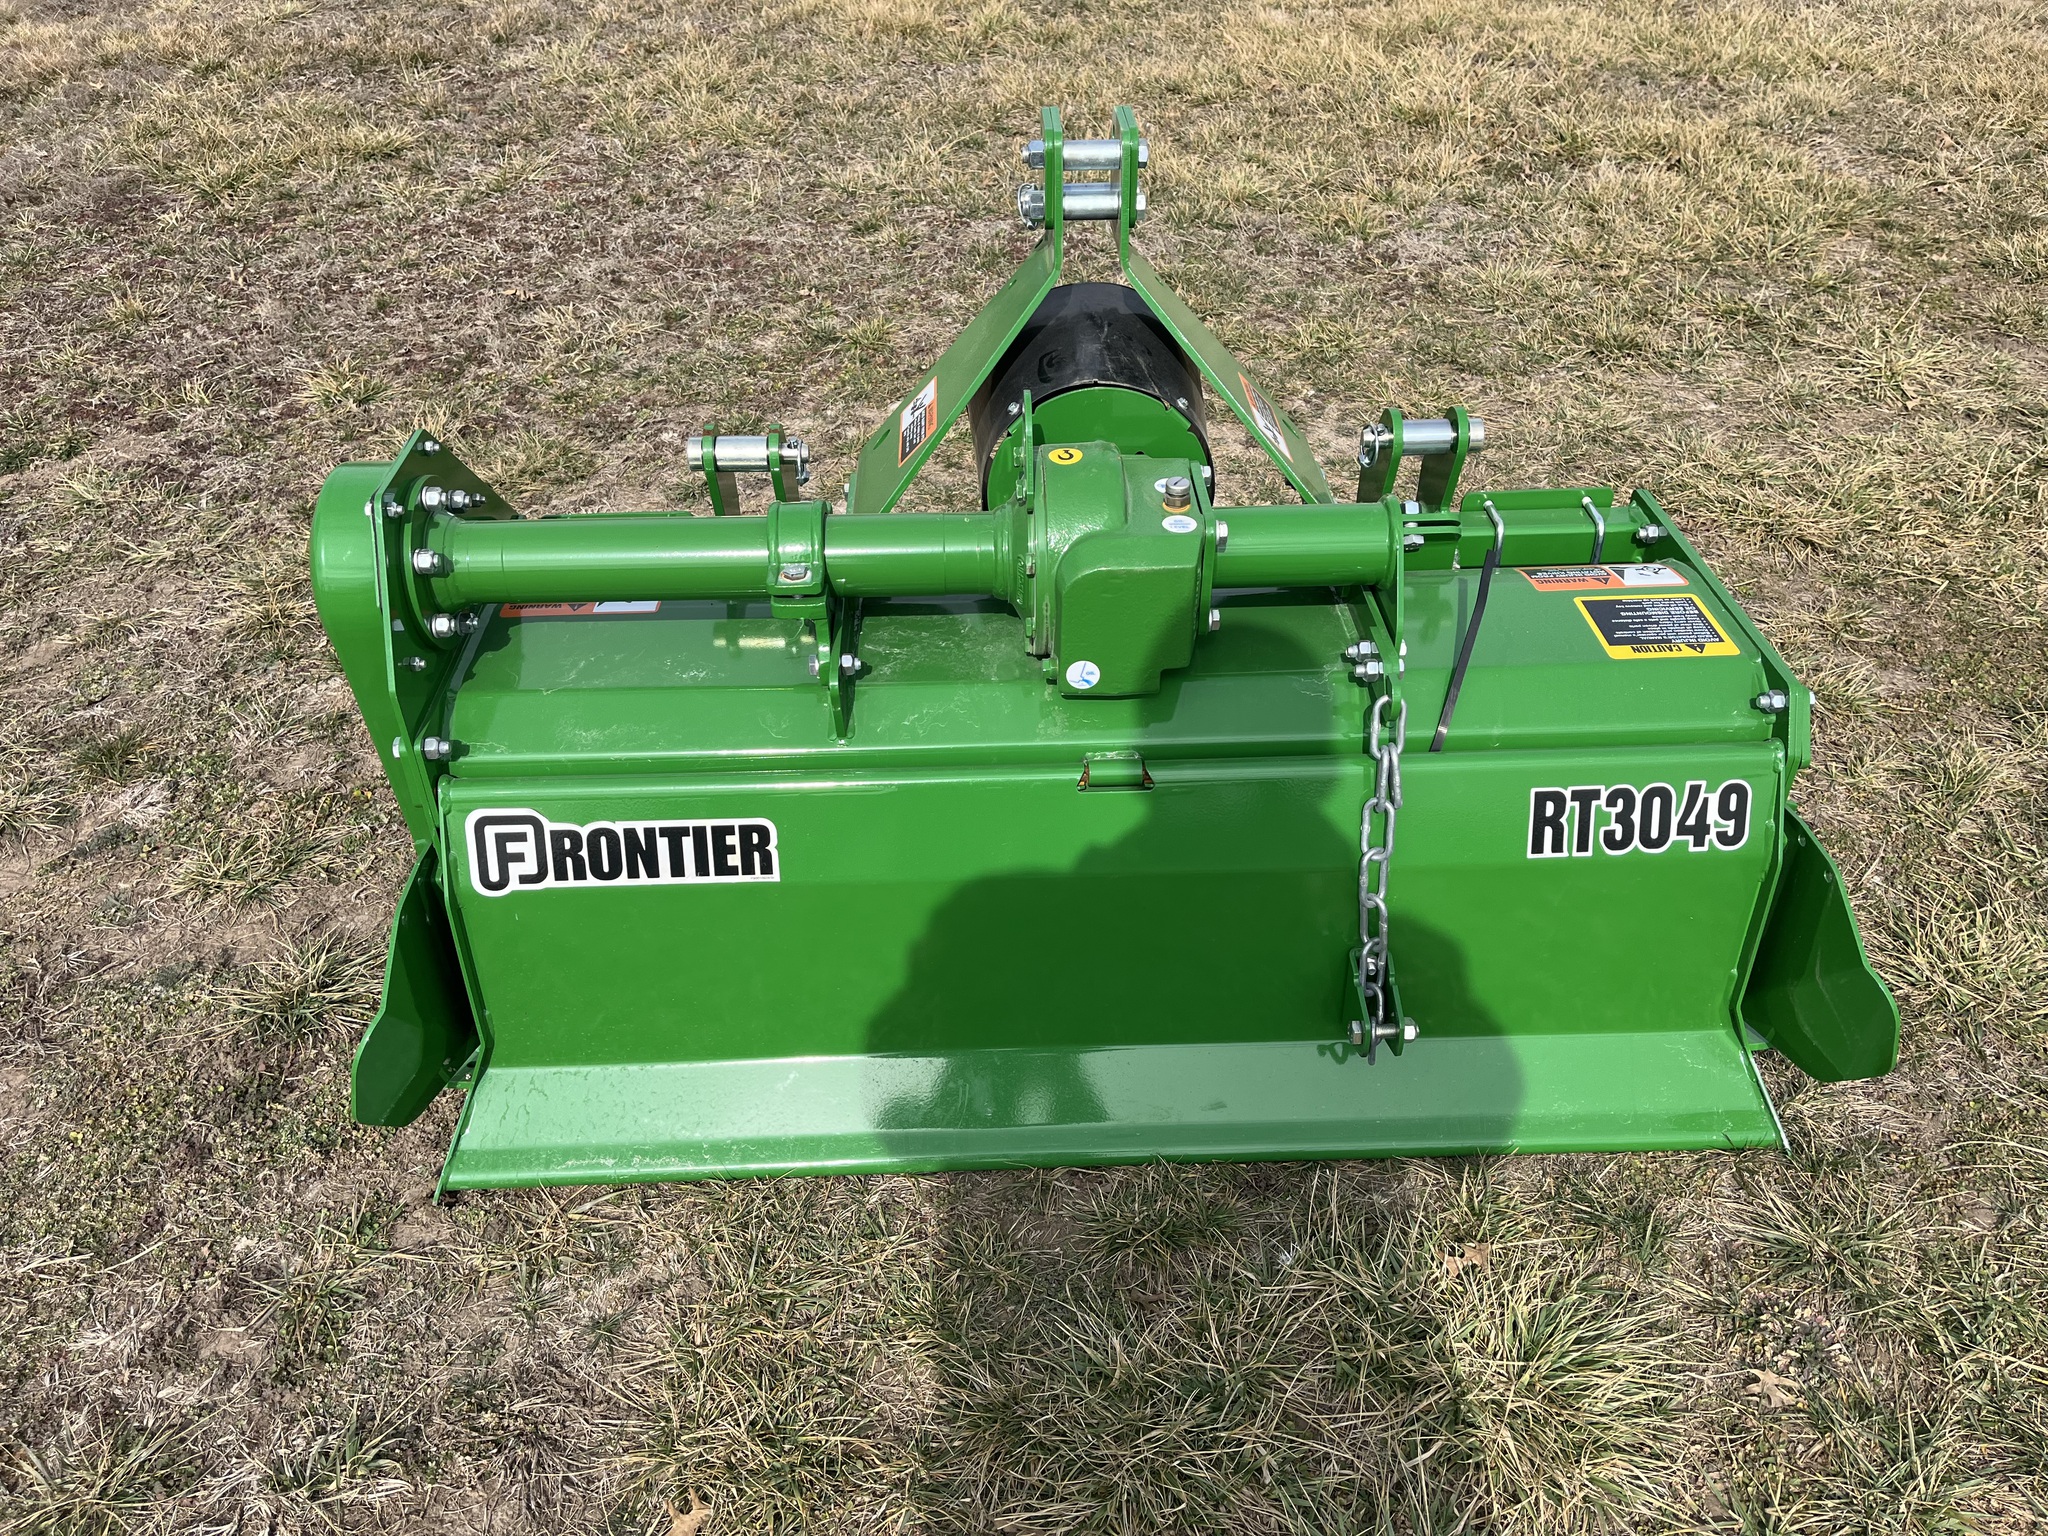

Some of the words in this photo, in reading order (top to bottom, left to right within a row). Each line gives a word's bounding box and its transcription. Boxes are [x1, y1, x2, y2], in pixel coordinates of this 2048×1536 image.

[1630, 644, 1682, 653] CAUTION
[474, 815, 774, 891] FRONTIER
[1531, 783, 1748, 854] RT3049
